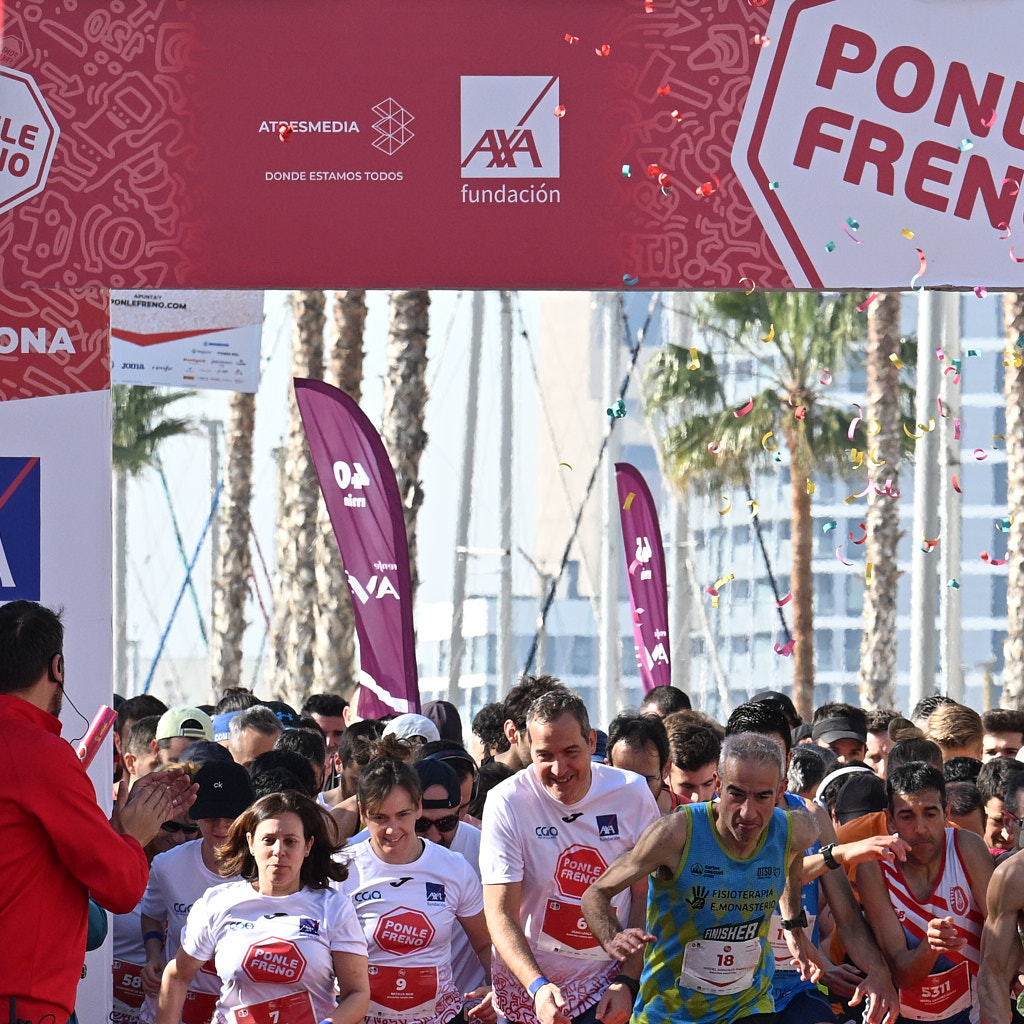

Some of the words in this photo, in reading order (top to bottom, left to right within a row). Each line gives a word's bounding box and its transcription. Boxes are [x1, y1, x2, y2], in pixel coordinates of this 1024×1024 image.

[258, 121, 360, 133] ATESMEDIA
[460, 129, 543, 168] AXA
[265, 171, 306, 181] DONDE
[309, 171, 362, 181] ESTAMOS
[364, 171, 404, 181] TODOS
[461, 183, 561, 203] fundación
[213, 781, 223, 789] ck
[563, 857, 602, 876] PONLE
[712, 888, 774, 899] FISIOTERAPIA
[384, 920, 429, 939] PONLE
[704, 922, 759, 940] FINISHER
[381, 930, 424, 946] FRENO
[254, 948, 299, 969] PONLE
[717, 954, 735, 966] 18
[250, 959, 295, 978] FRENO
[396, 978, 407, 991] 9
[269, 1010, 279, 1024] 7
